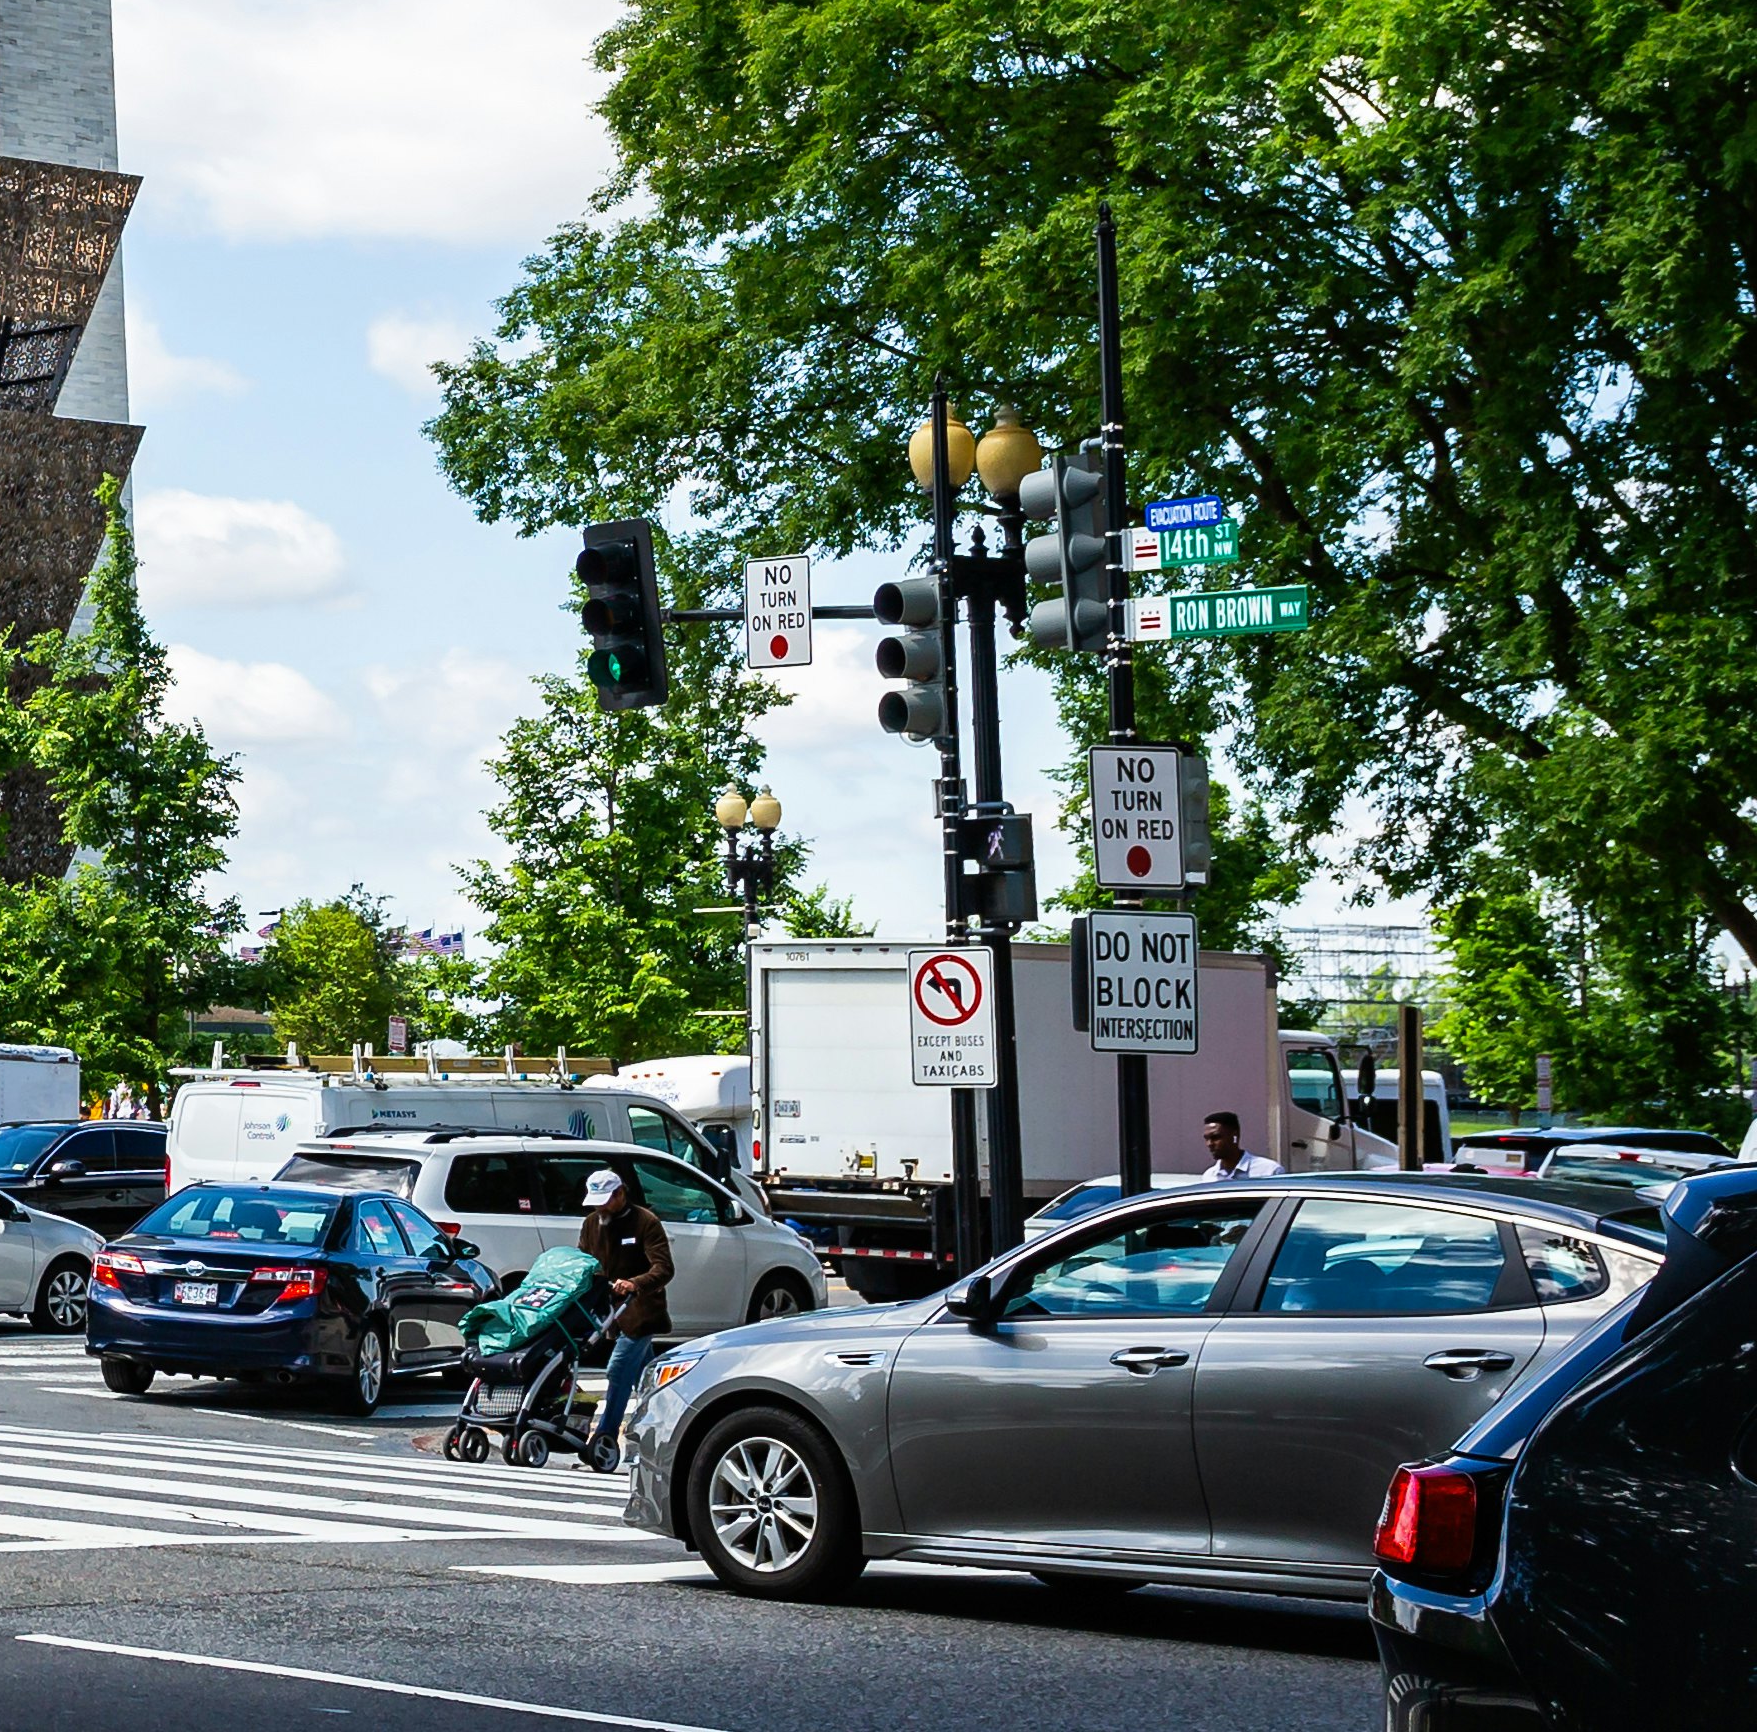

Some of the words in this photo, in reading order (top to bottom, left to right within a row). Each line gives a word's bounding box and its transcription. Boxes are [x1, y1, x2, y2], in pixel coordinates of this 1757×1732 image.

[1150, 504, 1192, 526] EVACUATION
[1193, 501, 1217, 521] ROUTE
[1163, 529, 1209, 561] 14th
[1215, 523, 1230, 539] ST
[1214, 541, 1233, 557] NW
[765, 565, 791, 586] NO
[760, 590, 796, 608] TURN
[752, 615, 771, 631] ON
[779, 612, 805, 630] RED
[1176, 600, 1209, 631] RON
[1215, 595, 1273, 628] BROWN
[1279, 600, 1301, 617] WAY
[1117, 757, 1155, 783] NO
[1111, 790, 1162, 811] TURN
[1102, 818, 1128, 839] ON
[1137, 819, 1174, 840] RED
[785, 952, 810, 961] 10761
[1096, 931, 1130, 962] DO
[1142, 932, 1190, 963] NOT
[1097, 976, 1192, 1009] BLOCK
[1096, 1017, 1193, 1040] INTERSECTION
[917, 1036, 951, 1047] EXCEPT
[955, 1035, 984, 1046] BUSES
[939, 1050, 962, 1061] AND
[923, 1065, 984, 1077] TAXICABS
[379, 1110, 416, 1118] METASYS
[243, 1121, 271, 1130] Johnson
[247, 1131, 275, 1140] Controls
